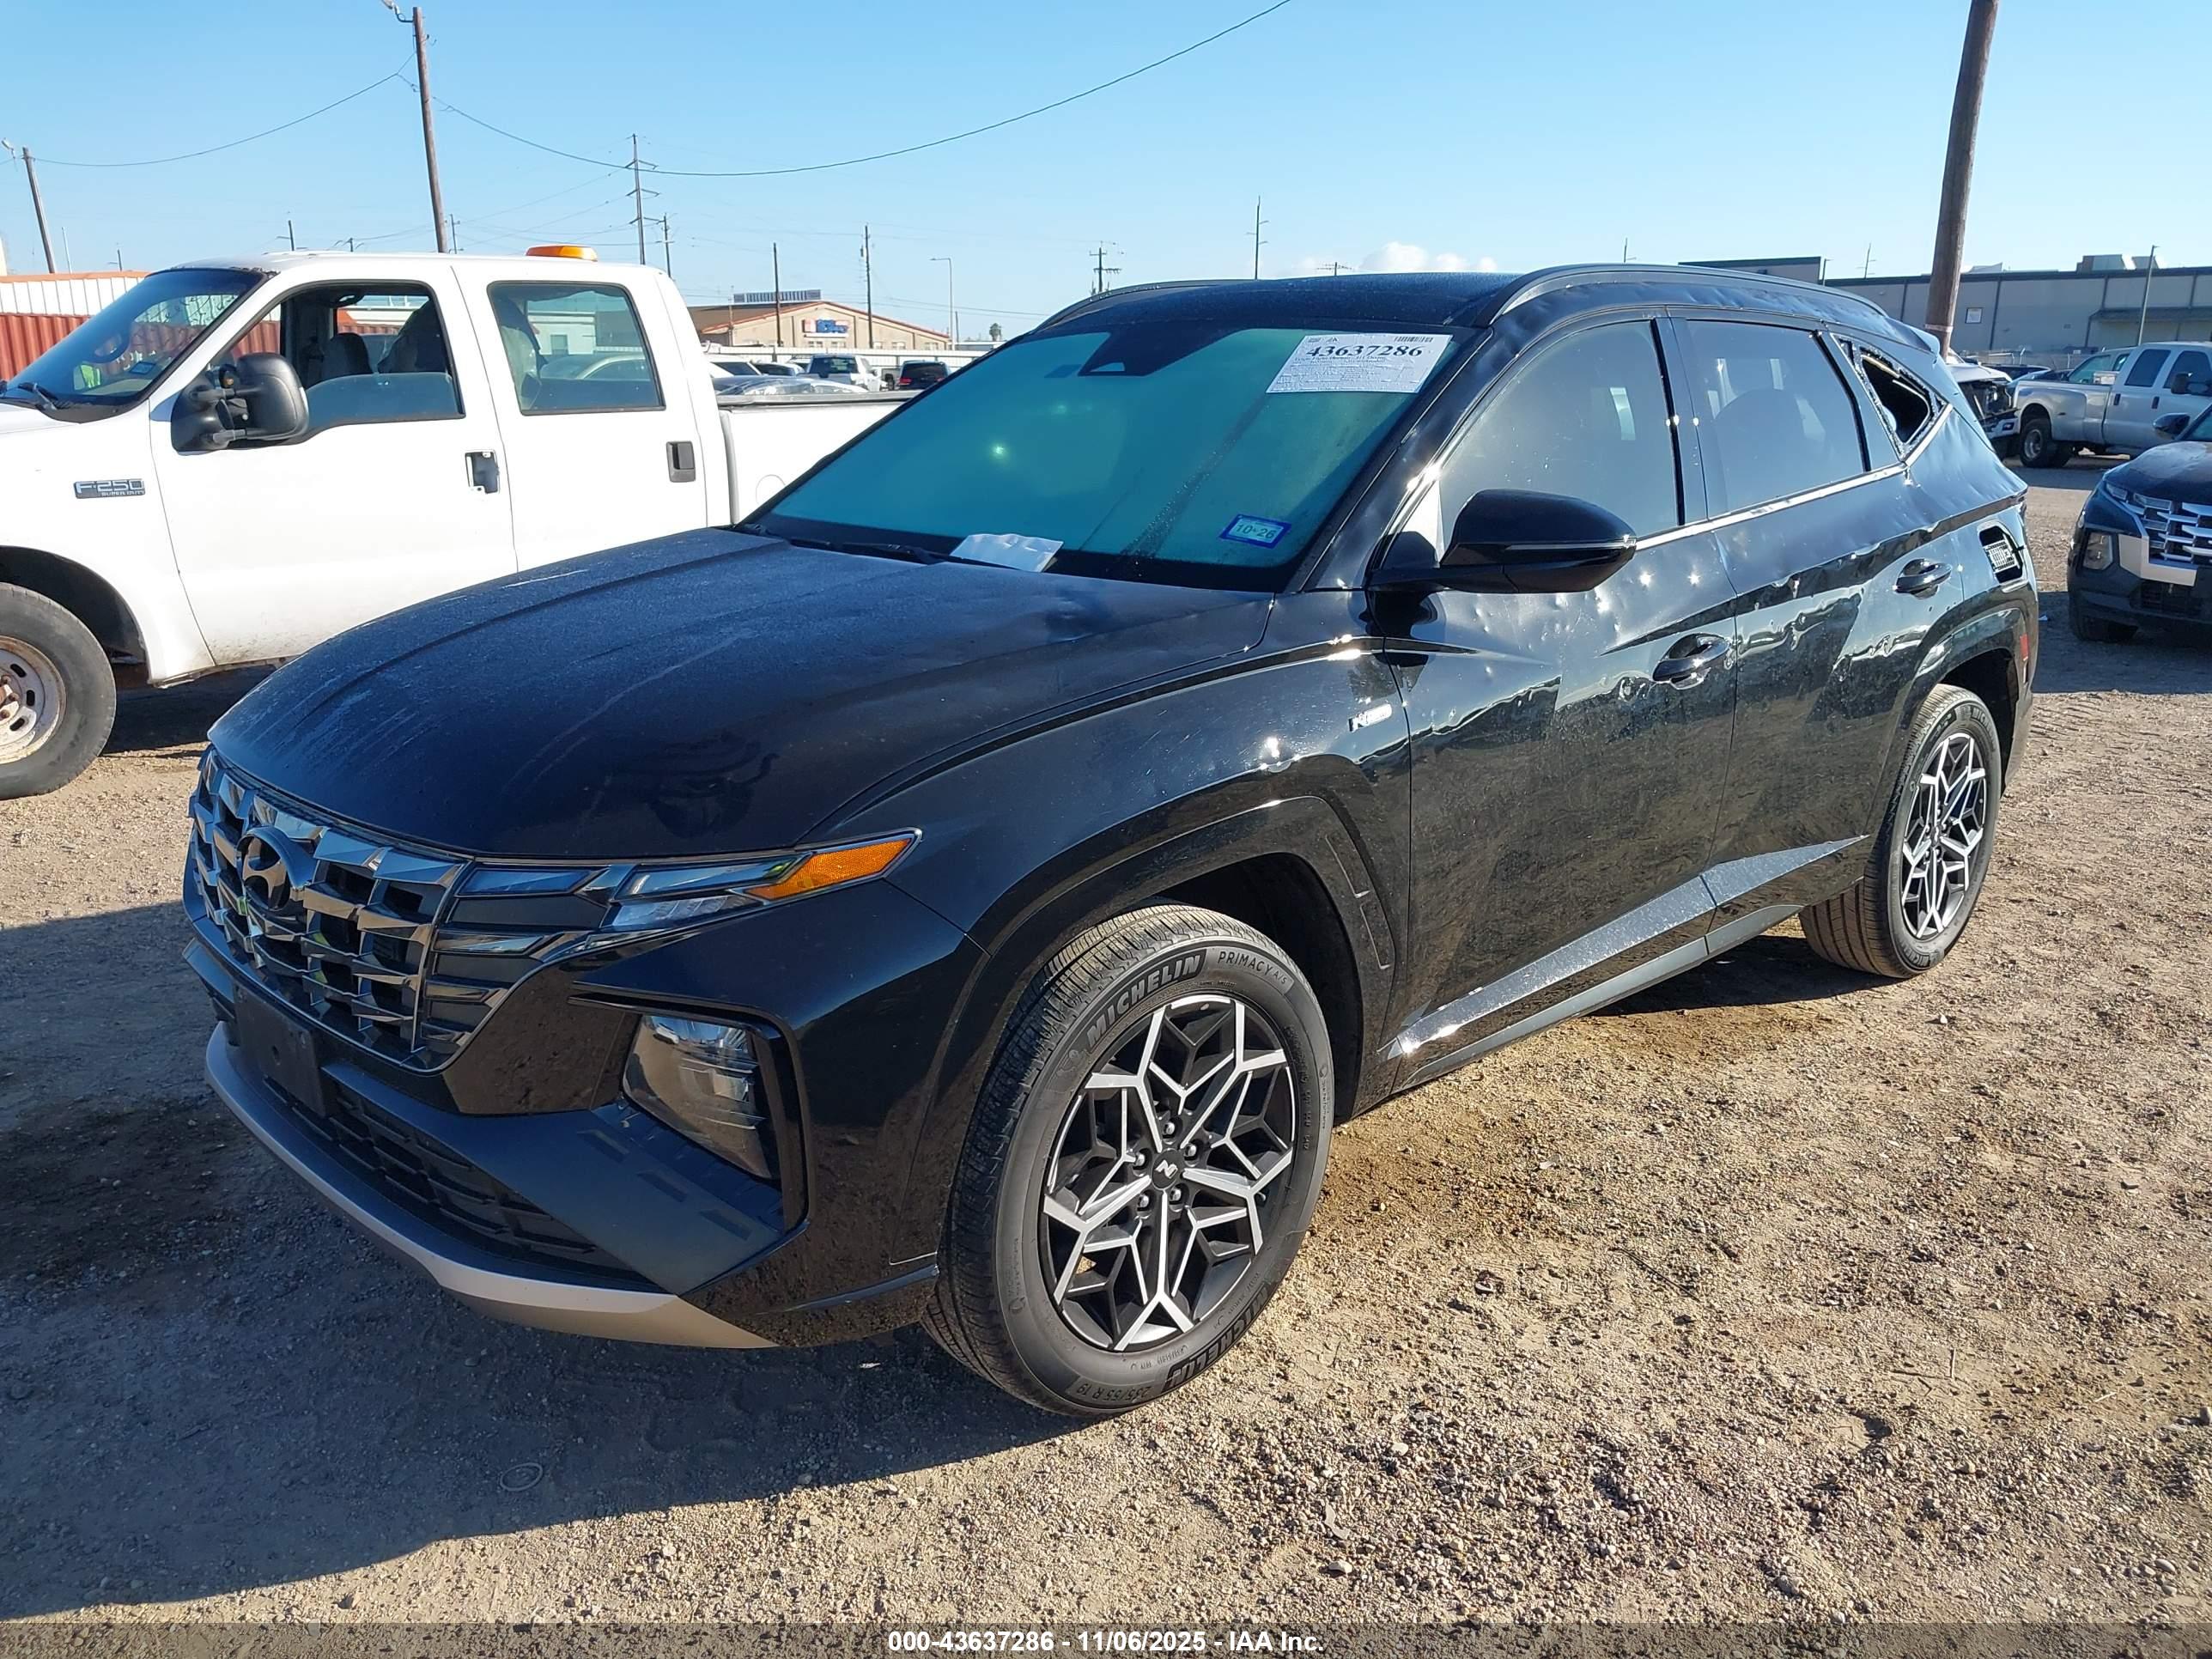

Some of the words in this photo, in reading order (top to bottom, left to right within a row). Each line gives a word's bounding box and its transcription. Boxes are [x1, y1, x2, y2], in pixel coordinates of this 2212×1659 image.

[1305, 345, 1426, 357] 43637286
[1218, 951, 1273, 978] PRIMACY
[1273, 970, 1288, 985] A/S
[1086, 955, 1200, 1047] MICHELIN
